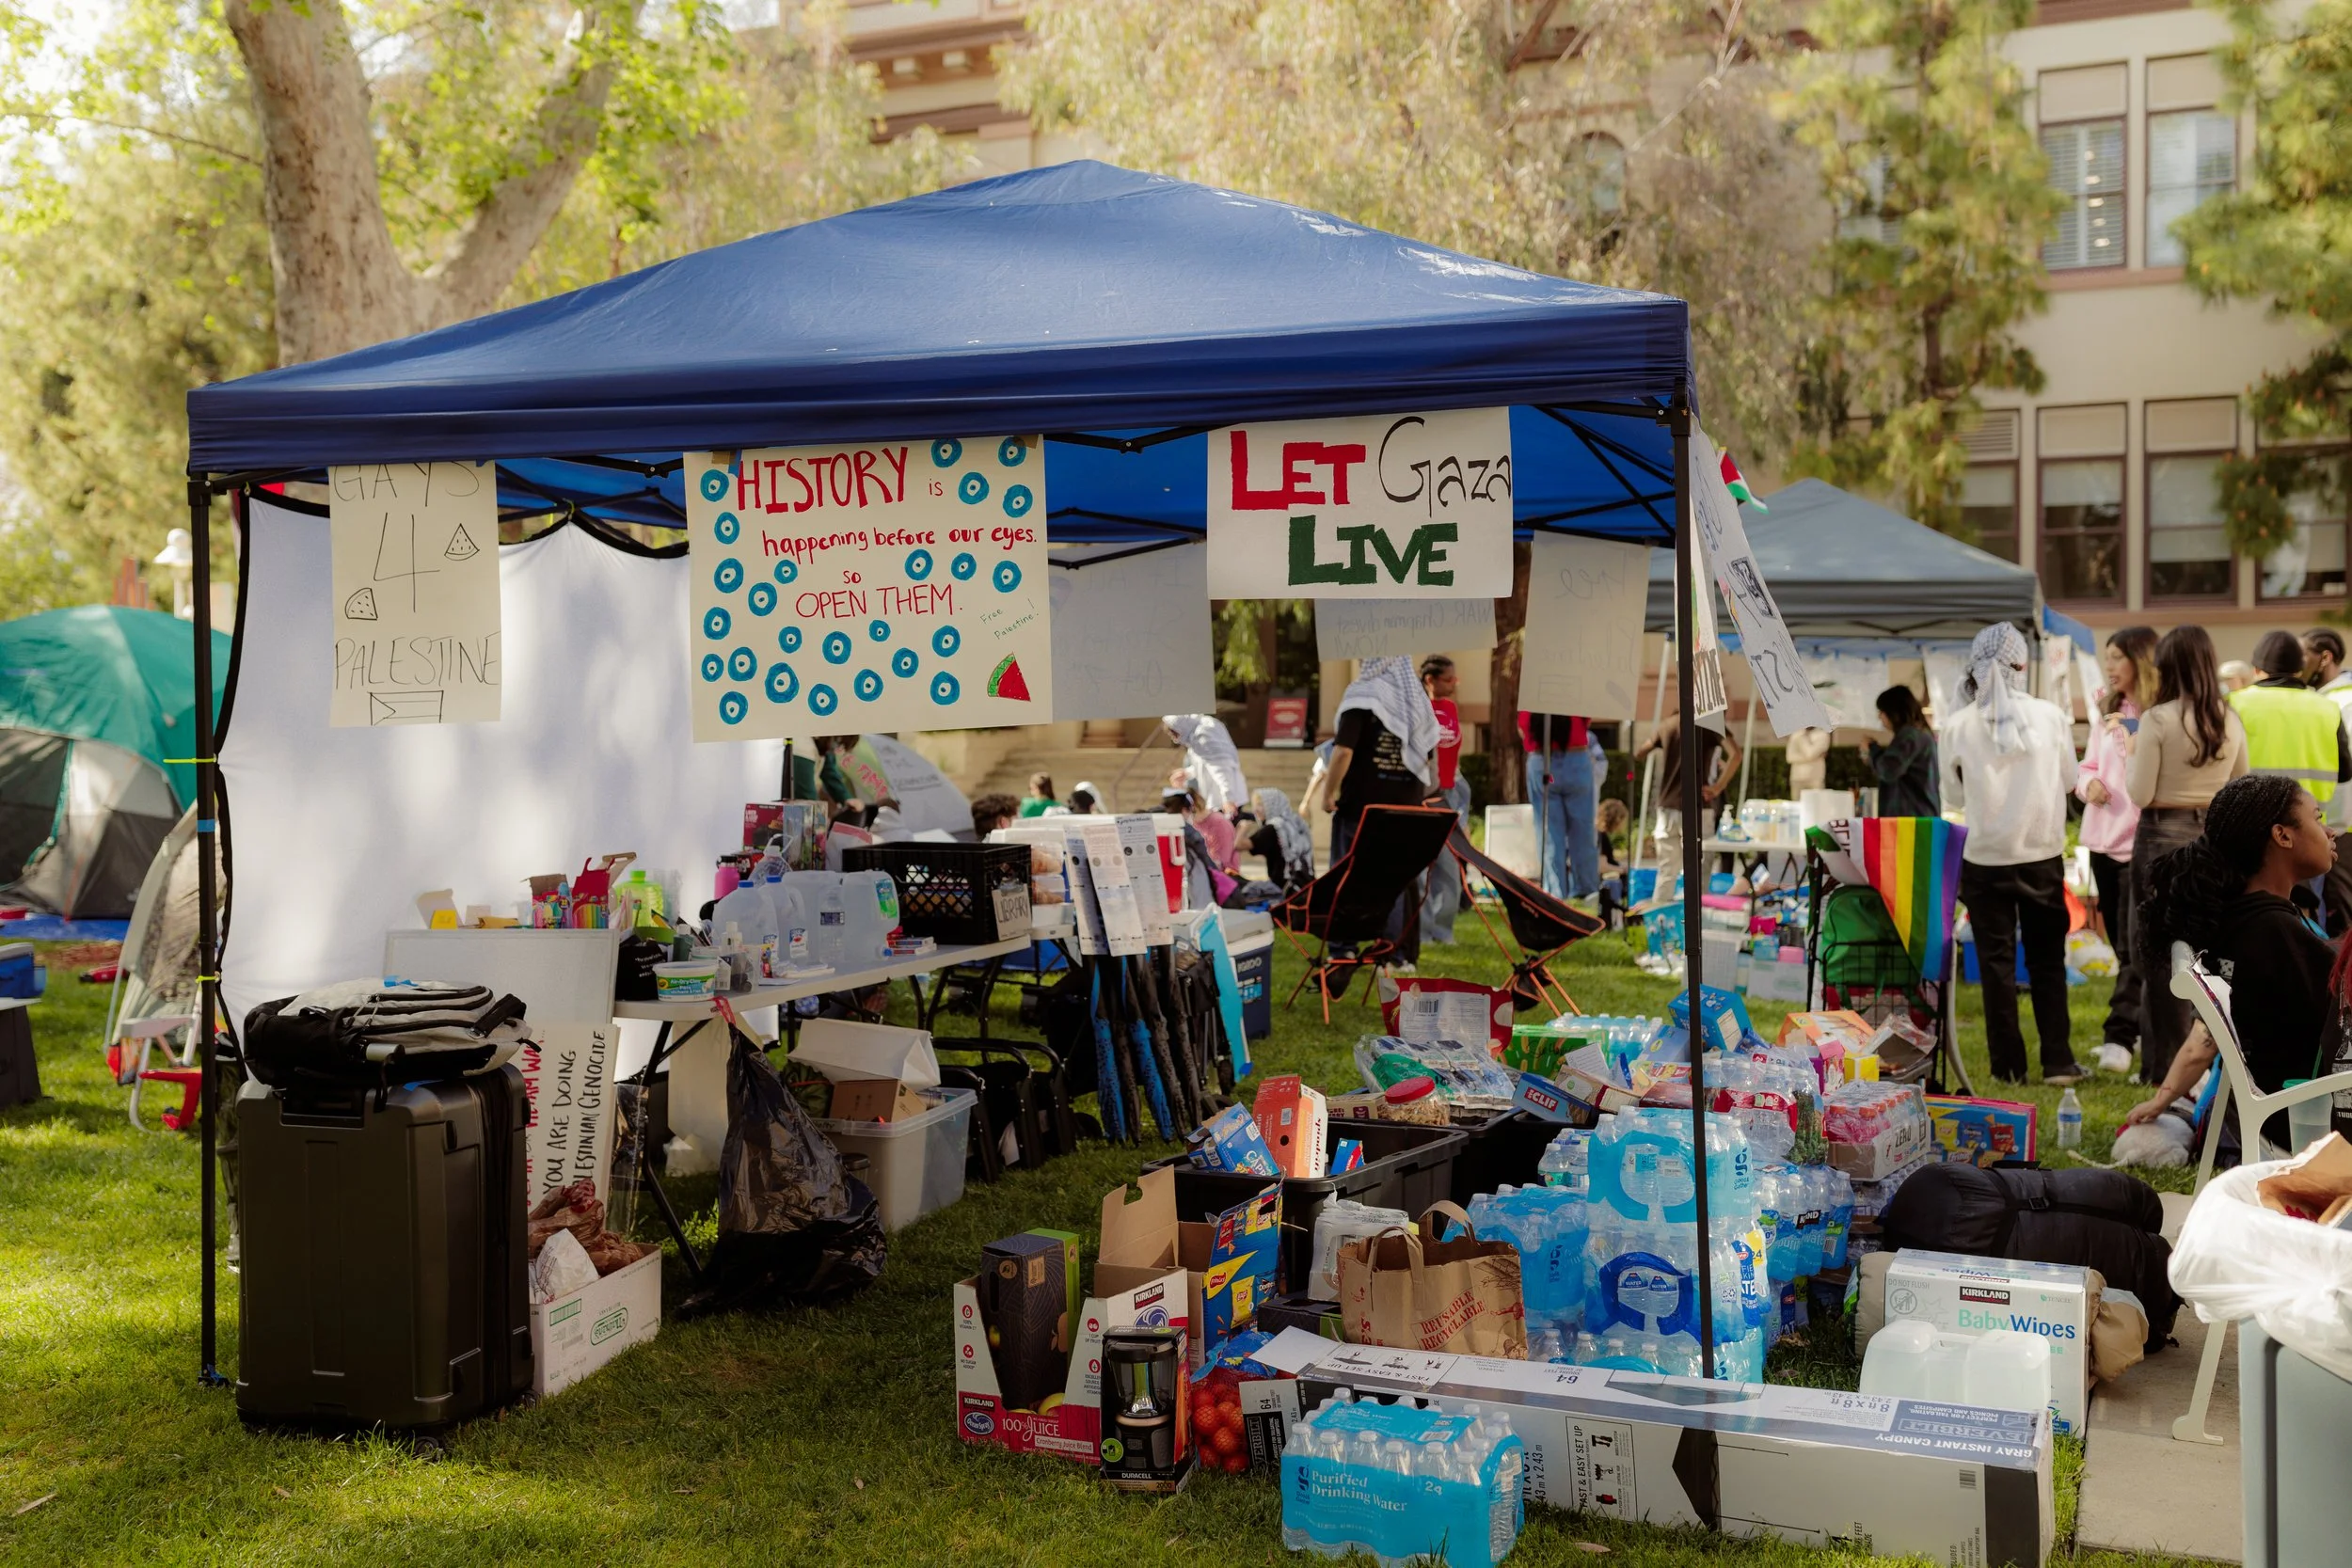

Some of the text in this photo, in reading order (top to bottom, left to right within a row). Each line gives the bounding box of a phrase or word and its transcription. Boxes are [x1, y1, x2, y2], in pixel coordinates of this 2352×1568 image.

[1231, 415, 1513, 517] LET Gaza
[334, 462, 481, 507] GAYS
[737, 447, 943, 514] HISTORY is
[762, 526, 1037, 564] happening before our eyes.
[1288, 515, 1458, 586] LIVE
[373, 513, 440, 613] 4
[843, 569, 861, 585] so
[795, 583, 962, 619] OPEN THEM.
[979, 607, 1003, 626] Free
[334, 631, 500, 690] PALESTINE
[997, 895, 1028, 924] LIBRARY
[1533, 1091, 1557, 1111] CLIF
[543, 1049, 577, 1195] YOU ARE DOING
[1895, 1124, 1912, 1148] ZERO
[1752, 1249, 1762, 1259] 24
[1135, 1284, 1164, 1304] KIRKLAND
[1962, 1288, 2009, 1300] KIRKLAND
[1419, 1290, 1475, 1335] REUSABLE
[1421, 1299, 1486, 1351] RECYCLABLE
[1958, 1308, 2075, 1338] Baby Wipes
[1406, 1373, 1429, 1382] FAST
[1556, 1374, 1578, 1384] 64
[964, 1397, 994, 1408] KIRKLAND
[1259, 1398, 1272, 1410] 64
[1830, 1398, 1839, 1406] ft
[1843, 1399, 1854, 1410] 8
[1868, 1402, 1878, 1411] ft
[1880, 1402, 1890, 1413] 8
[1914, 1404, 1952, 1414] CAMPSITES
[1964, 1414, 1998, 1422] PERFECT
[1969, 1409, 1998, 1418] PICNICS
[1002, 1416, 1060, 1442] 100% JUICE
[1573, 1425, 1583, 1437] UP
[1905, 1420, 2023, 1441] EVERBILT
[1063, 1440, 1076, 1449] Juice
[1076, 1442, 1092, 1451] Blend
[1249, 1418, 1263, 1465] VERBILT
[1575, 1439, 1584, 1454] SET
[1874, 1433, 2033, 1458] GRAY INSTANT CANOPY
[1532, 1452, 1543, 1472] 2.43
[1576, 1455, 1586, 1477] EASY
[1311, 1470, 1368, 1488] Purified
[1424, 1481, 1443, 1496] 24
[1311, 1483, 1407, 1512] Drinking Water
[1578, 1487, 1588, 1509] FAST
[1854, 1521, 1863, 1537] FEET
